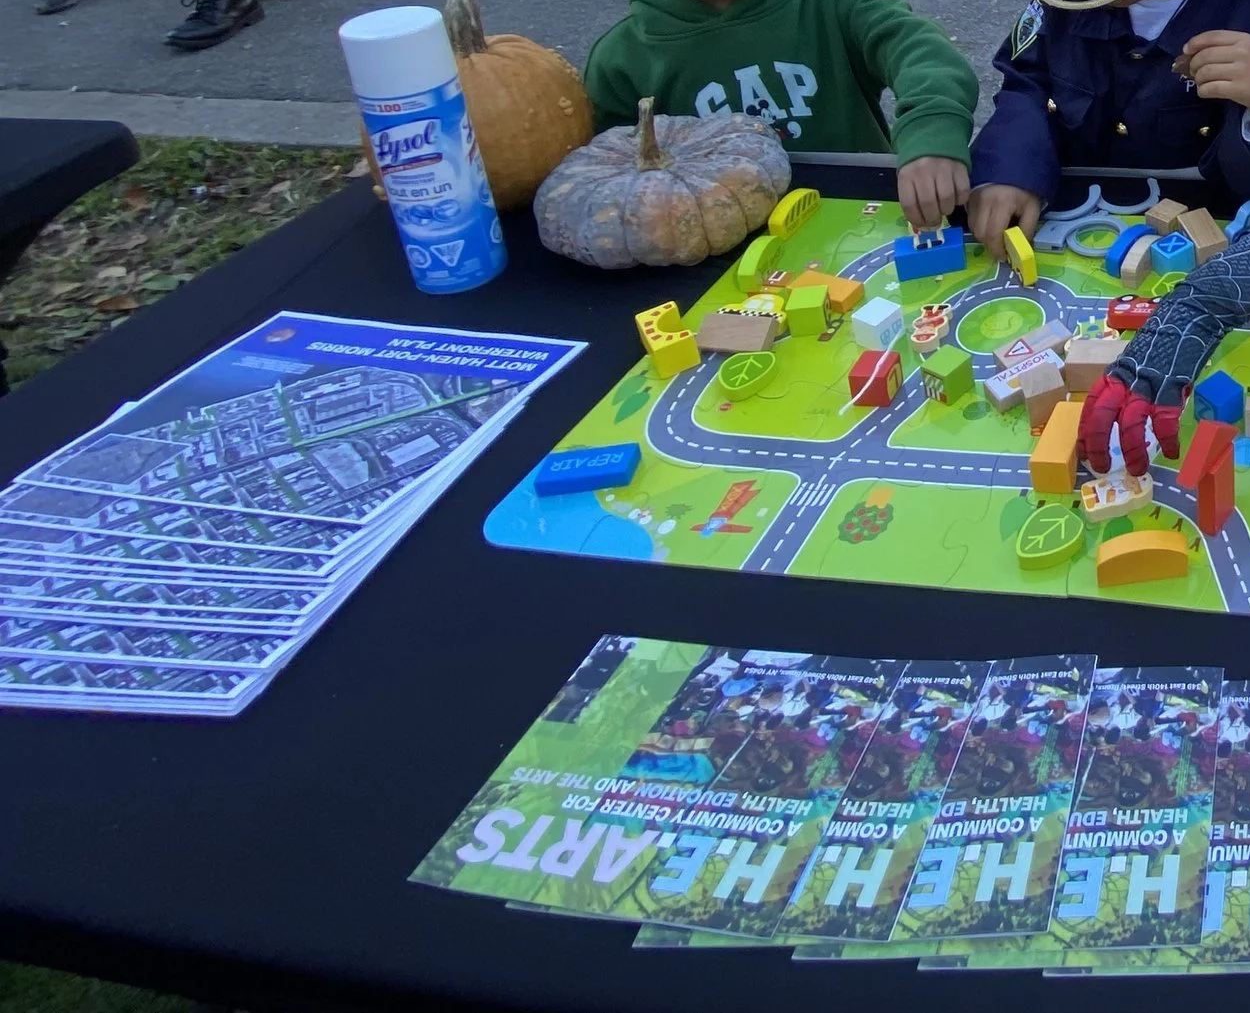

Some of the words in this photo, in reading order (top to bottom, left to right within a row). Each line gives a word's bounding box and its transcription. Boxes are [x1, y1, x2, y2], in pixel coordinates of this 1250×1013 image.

[375, 121, 438, 163] Lysol
[389, 186, 409, 200] out
[1158, 236, 1186, 253] X
[305, 342, 372, 358] MORRIS
[386, 338, 431, 351] PLAN
[432, 341, 550, 361] WATERFRONT
[374, 349, 490, 369] HAVEN-PORT
[496, 361, 539, 373] MOTT
[993, 351, 1051, 383] HOSPITAL
[550, 451, 625, 472] REPAIR
[743, 666, 766, 675] 10454
[766, 668, 778, 676] NY
[827, 673, 846, 682] 140th
[1018, 672, 1039, 681] 140th
[1040, 671, 1057, 680] East
[1057, 670, 1073, 679] 349
[847, 675, 864, 683] East
[864, 676, 879, 684] 349
[912, 676, 933, 685] 140th
[934, 677, 950, 685] East
[951, 677, 965, 686] 349
[1147, 682, 1168, 692] 140th
[1169, 682, 1186, 691] East
[1187, 682, 1202, 691] 349
[509, 766, 559, 785] ARTS
[557, 772, 592, 790] THE
[593, 777, 635, 795] AND
[561, 793, 599, 812] FOR
[633, 782, 738, 808] EDUCATION
[741, 791, 813, 815] HEALTH,
[598, 798, 671, 822] CENTER
[842, 798, 915, 819] HEALTH,
[971, 795, 1048, 813] HEALTH,
[669, 808, 785, 835] COMMUNITY
[1028, 816, 1045, 831] A
[1111, 807, 1189, 825] HEALTH,
[789, 820, 804, 837] A
[822, 820, 888, 839] COMM
[892, 823, 908, 840] A
[1171, 828, 1186, 844] A
